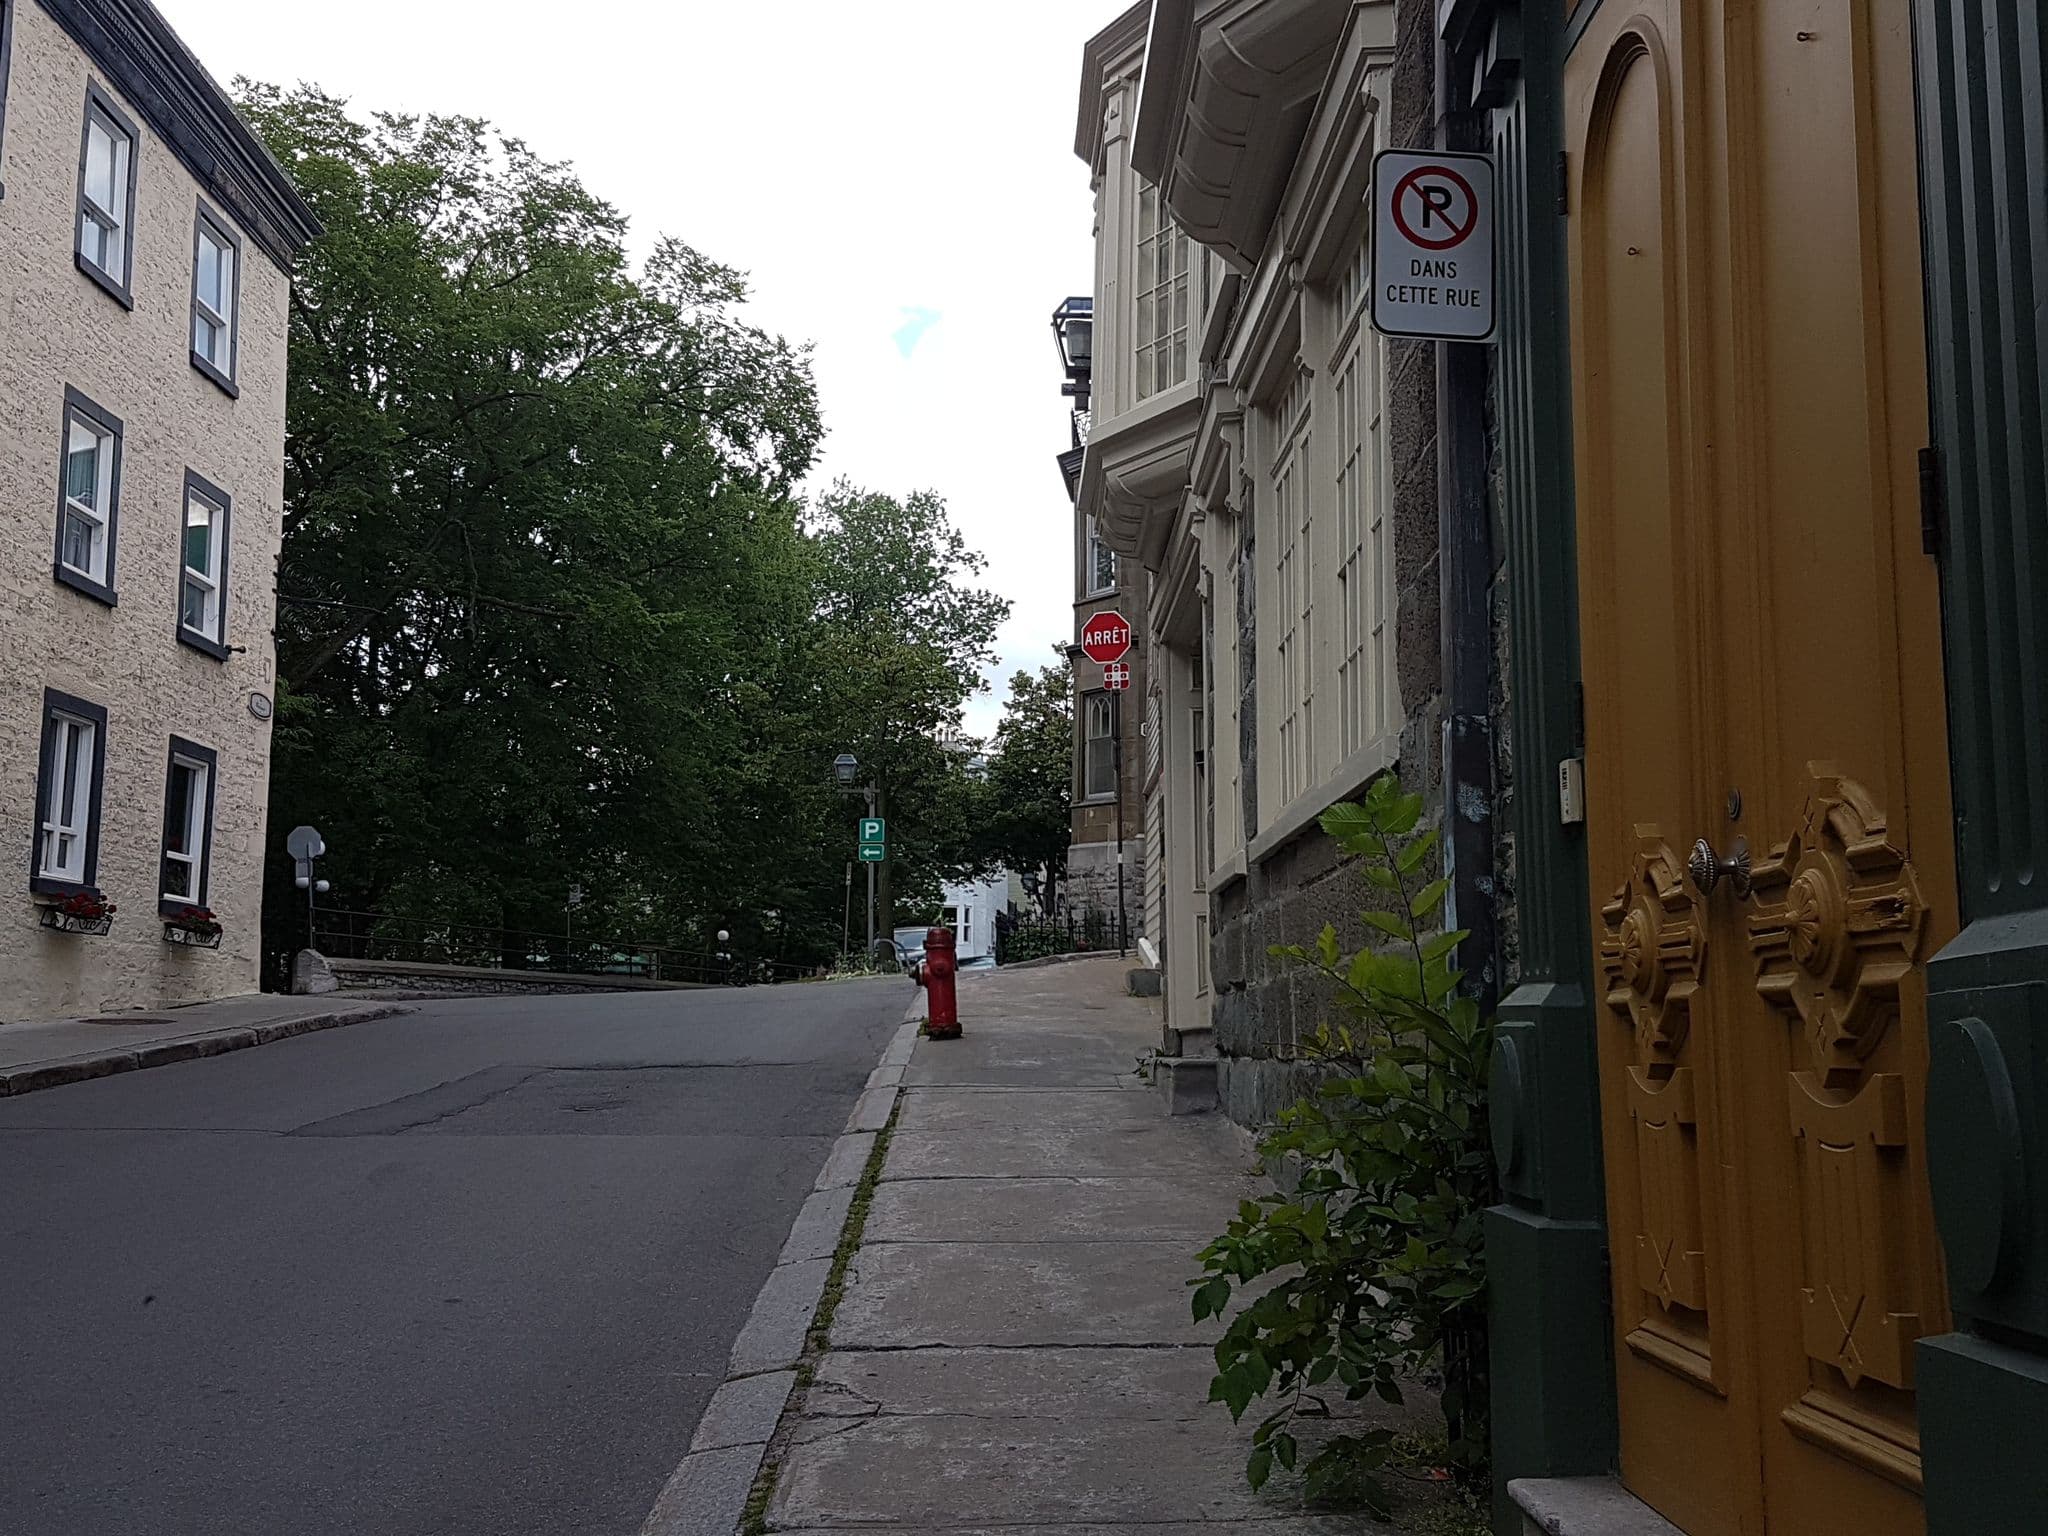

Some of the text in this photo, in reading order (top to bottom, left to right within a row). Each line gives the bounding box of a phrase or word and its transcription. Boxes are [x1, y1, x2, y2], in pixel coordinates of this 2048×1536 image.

[1422, 185, 1452, 229] P
[1410, 259, 1457, 279] DANS
[1386, 285, 1481, 307] CETTE RUE
[1085, 626, 1128, 647] ARRÊT
[865, 822, 879, 839] P
